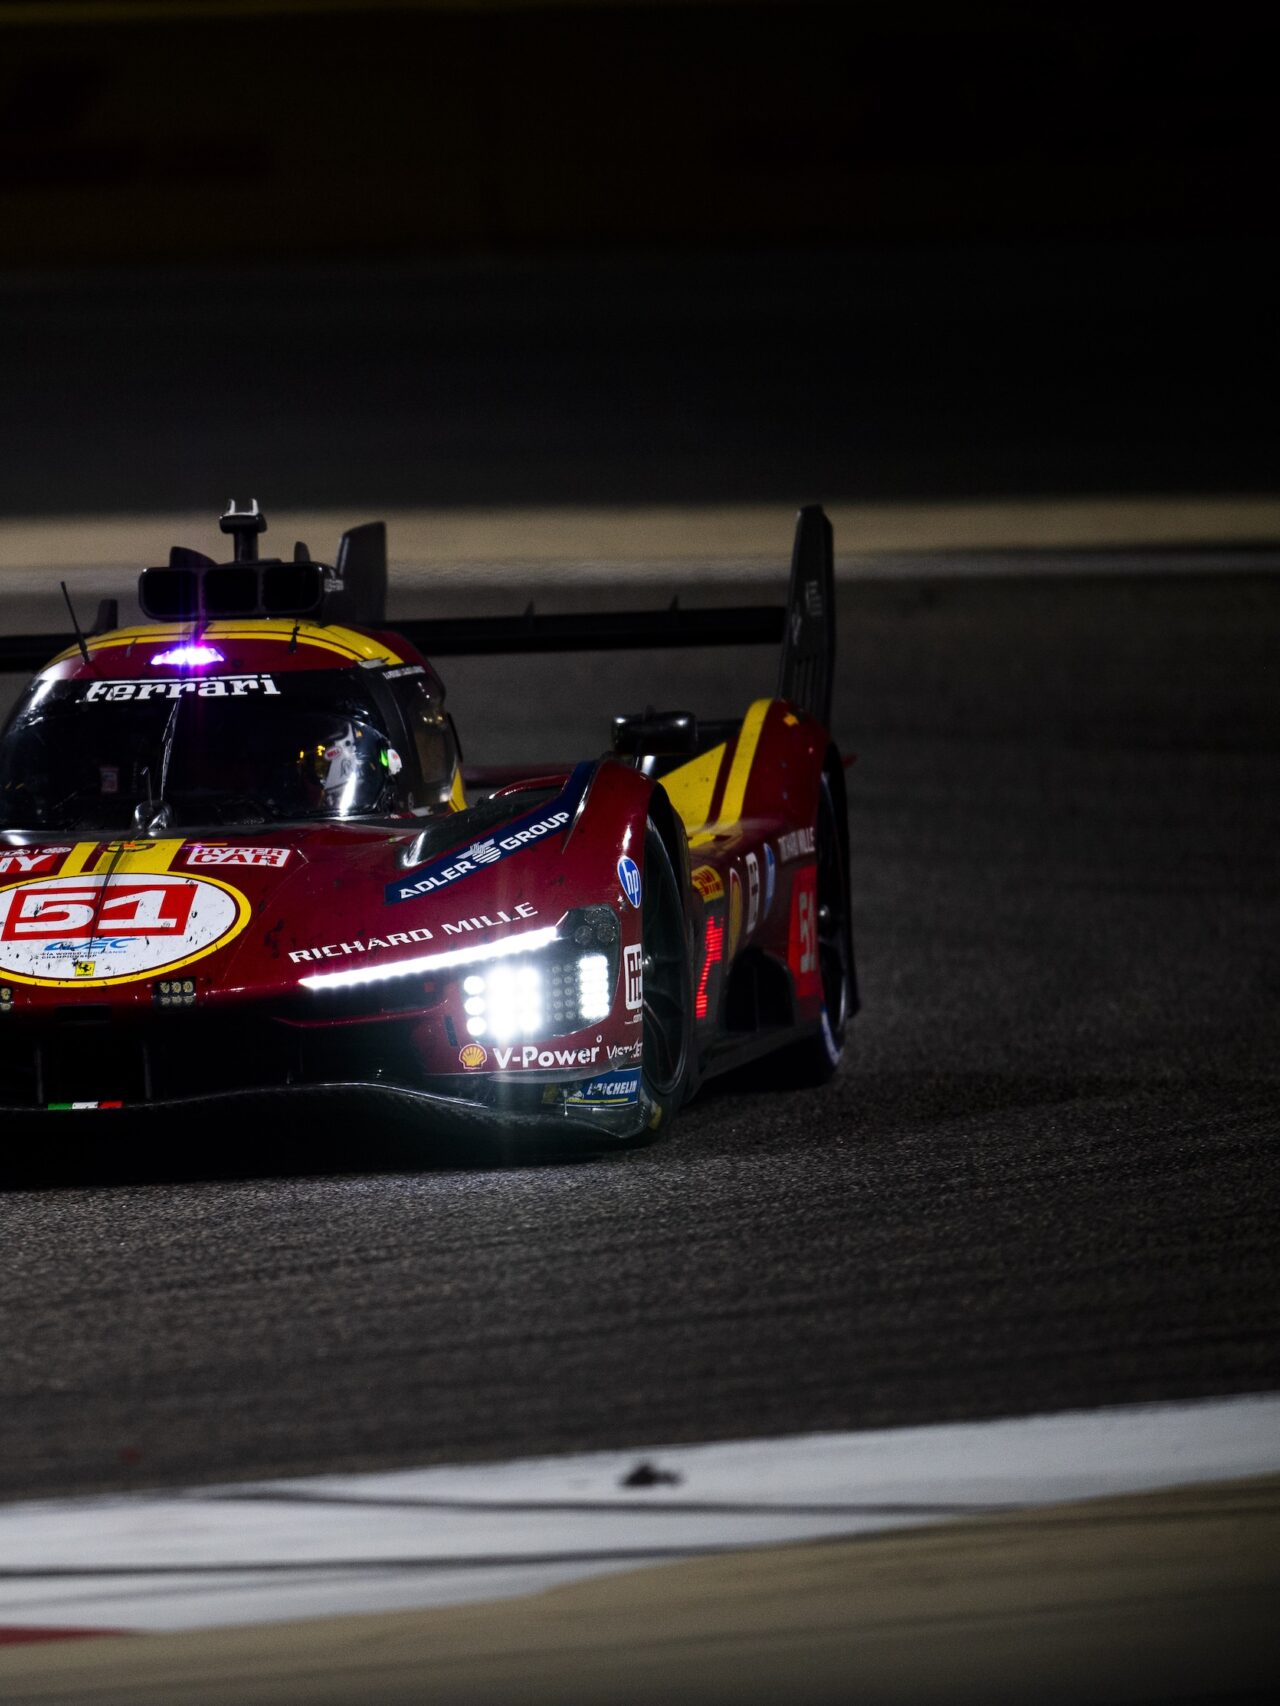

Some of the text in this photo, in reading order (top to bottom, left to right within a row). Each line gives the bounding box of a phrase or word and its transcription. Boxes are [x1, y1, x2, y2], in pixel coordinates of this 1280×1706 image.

[85, 674, 282, 703] Ferrari
[193, 853, 281, 865] CAR
[196, 848, 283, 856] HYPER
[400, 811, 570, 899] ADLER GROUP
[623, 863, 641, 897] hp
[14, 889, 178, 933] 51
[288, 901, 539, 963] RICHARD MILLE
[493, 1045, 600, 1069] V-Power
[586, 1079, 638, 1096] MICHELIN
